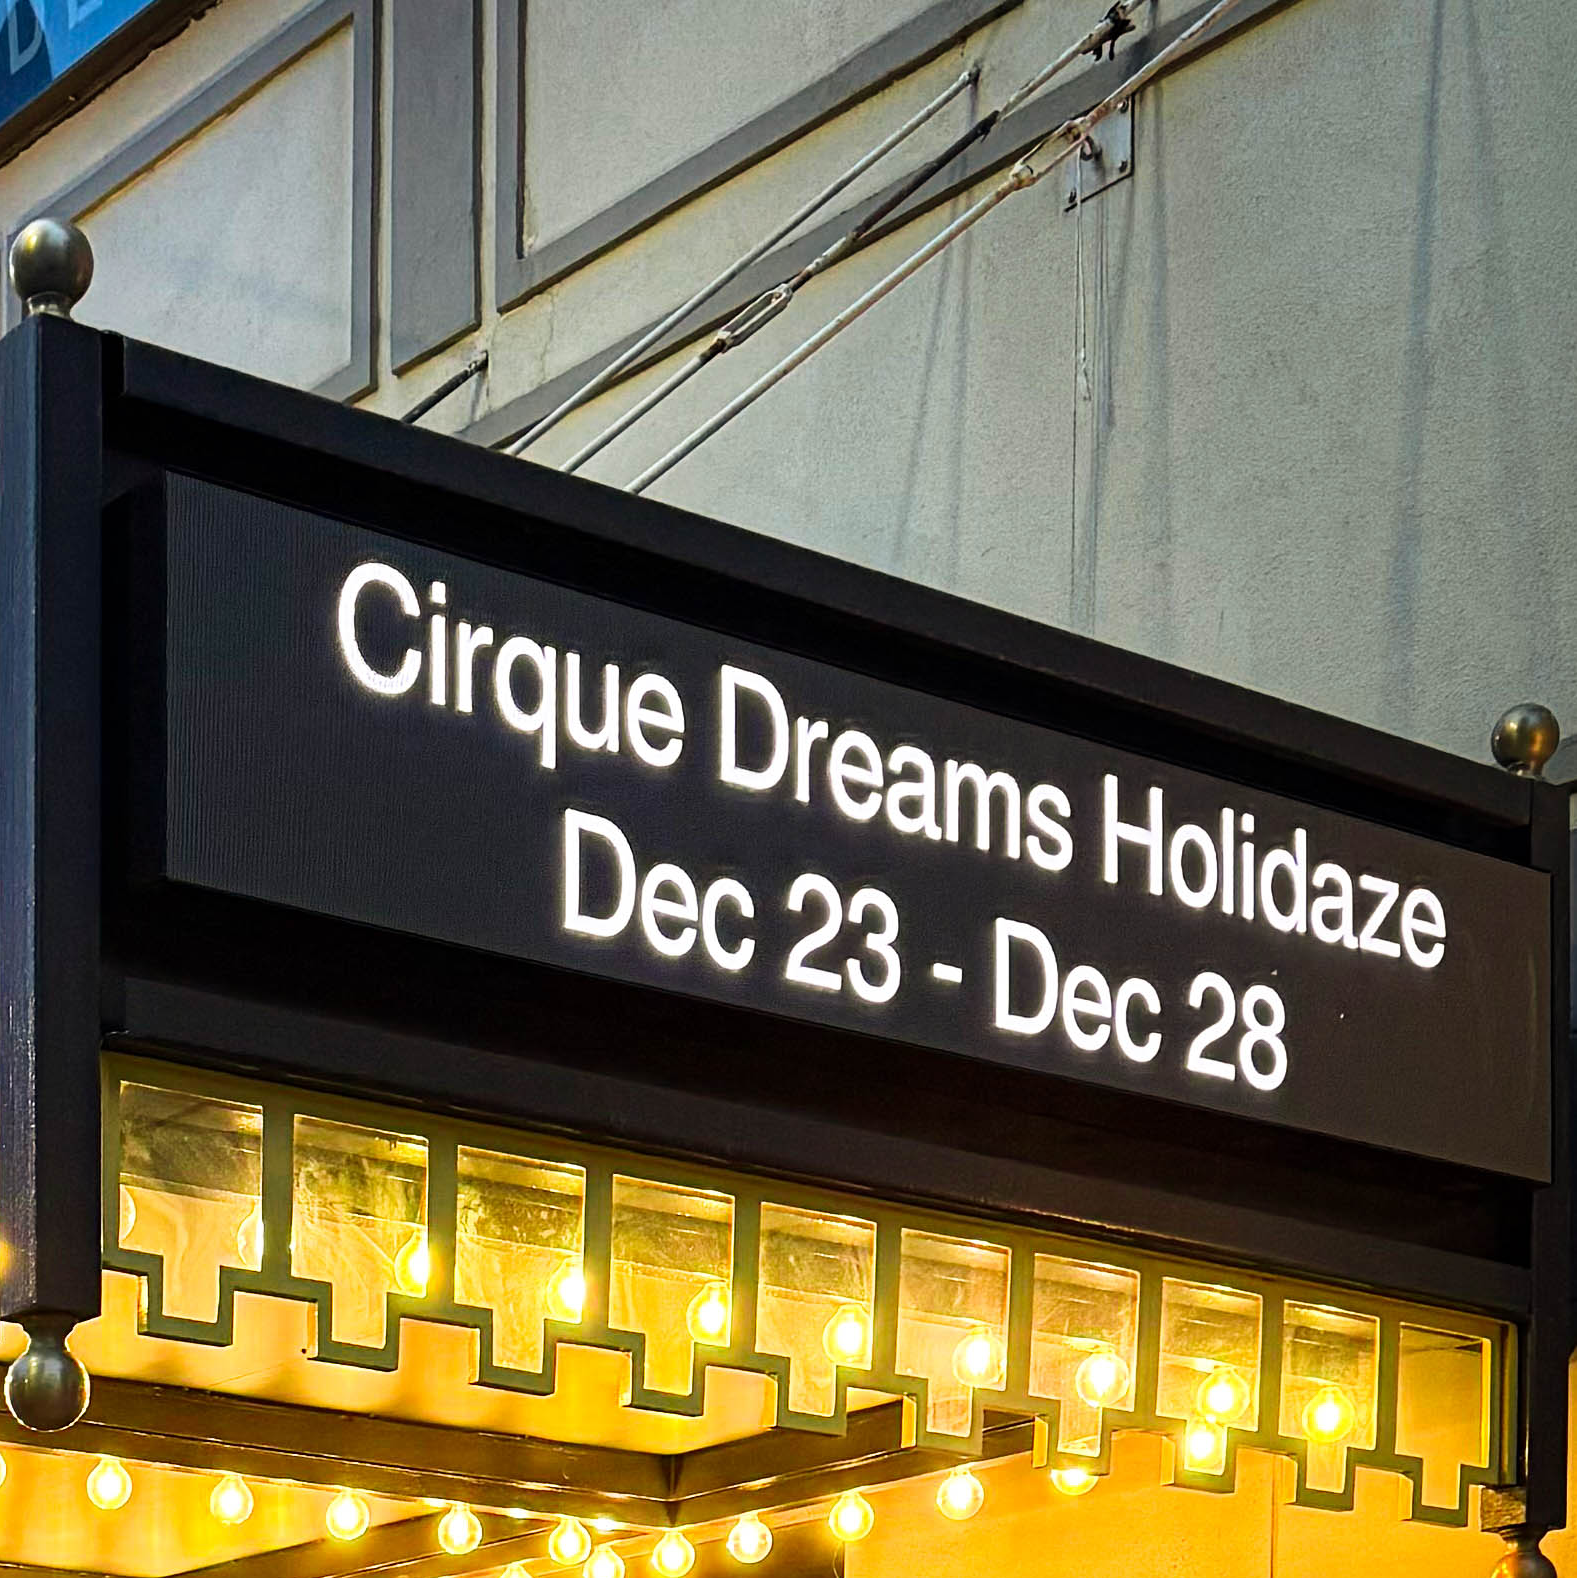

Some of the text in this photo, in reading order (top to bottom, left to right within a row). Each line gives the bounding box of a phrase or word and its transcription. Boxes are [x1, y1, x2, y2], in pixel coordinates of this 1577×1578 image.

[338, 562, 1446, 969] Cirque Dreams Holidaze
[564, 808, 1288, 1091] Dec 23 - Dec 28
